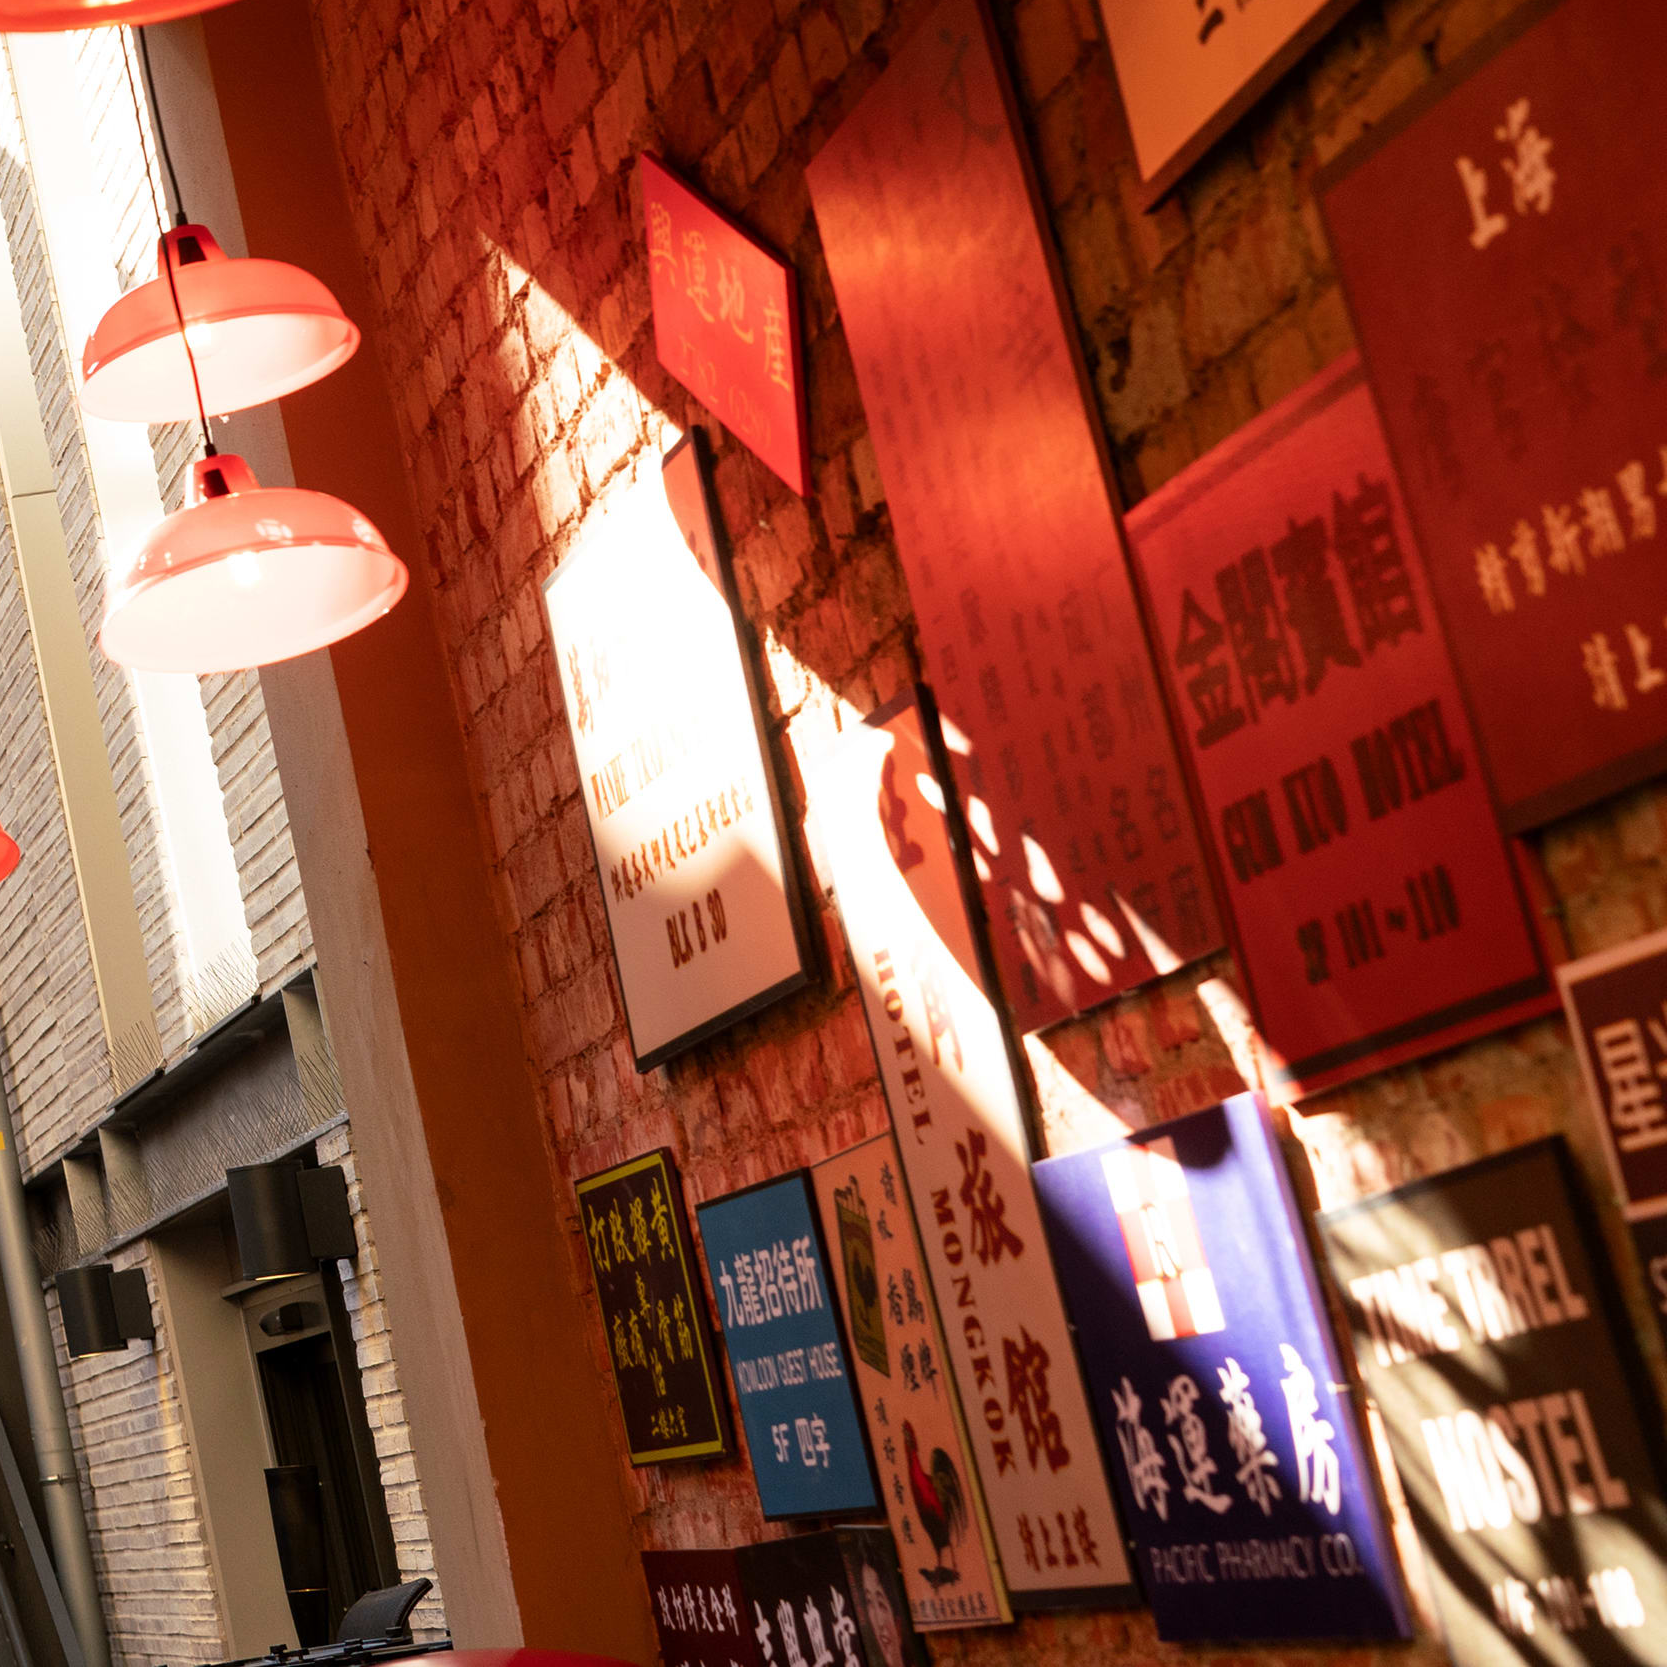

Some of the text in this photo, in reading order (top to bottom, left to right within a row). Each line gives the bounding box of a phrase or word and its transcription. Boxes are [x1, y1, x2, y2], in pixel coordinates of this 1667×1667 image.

[666, 909, 693, 970] BLK
[693, 899, 707, 954] B
[874, 948, 1019, 1478] HOTEL MONGKOK
[719, 1234, 824, 1330] 九龍招待所
[735, 1341, 843, 1395] KOWLOON GUEST HOUSE
[1420, 1388, 1632, 1533] HOSTEL
[1149, 1542, 1216, 1585] PACIFIC
[1216, 1534, 1315, 1580] PHARMACY
